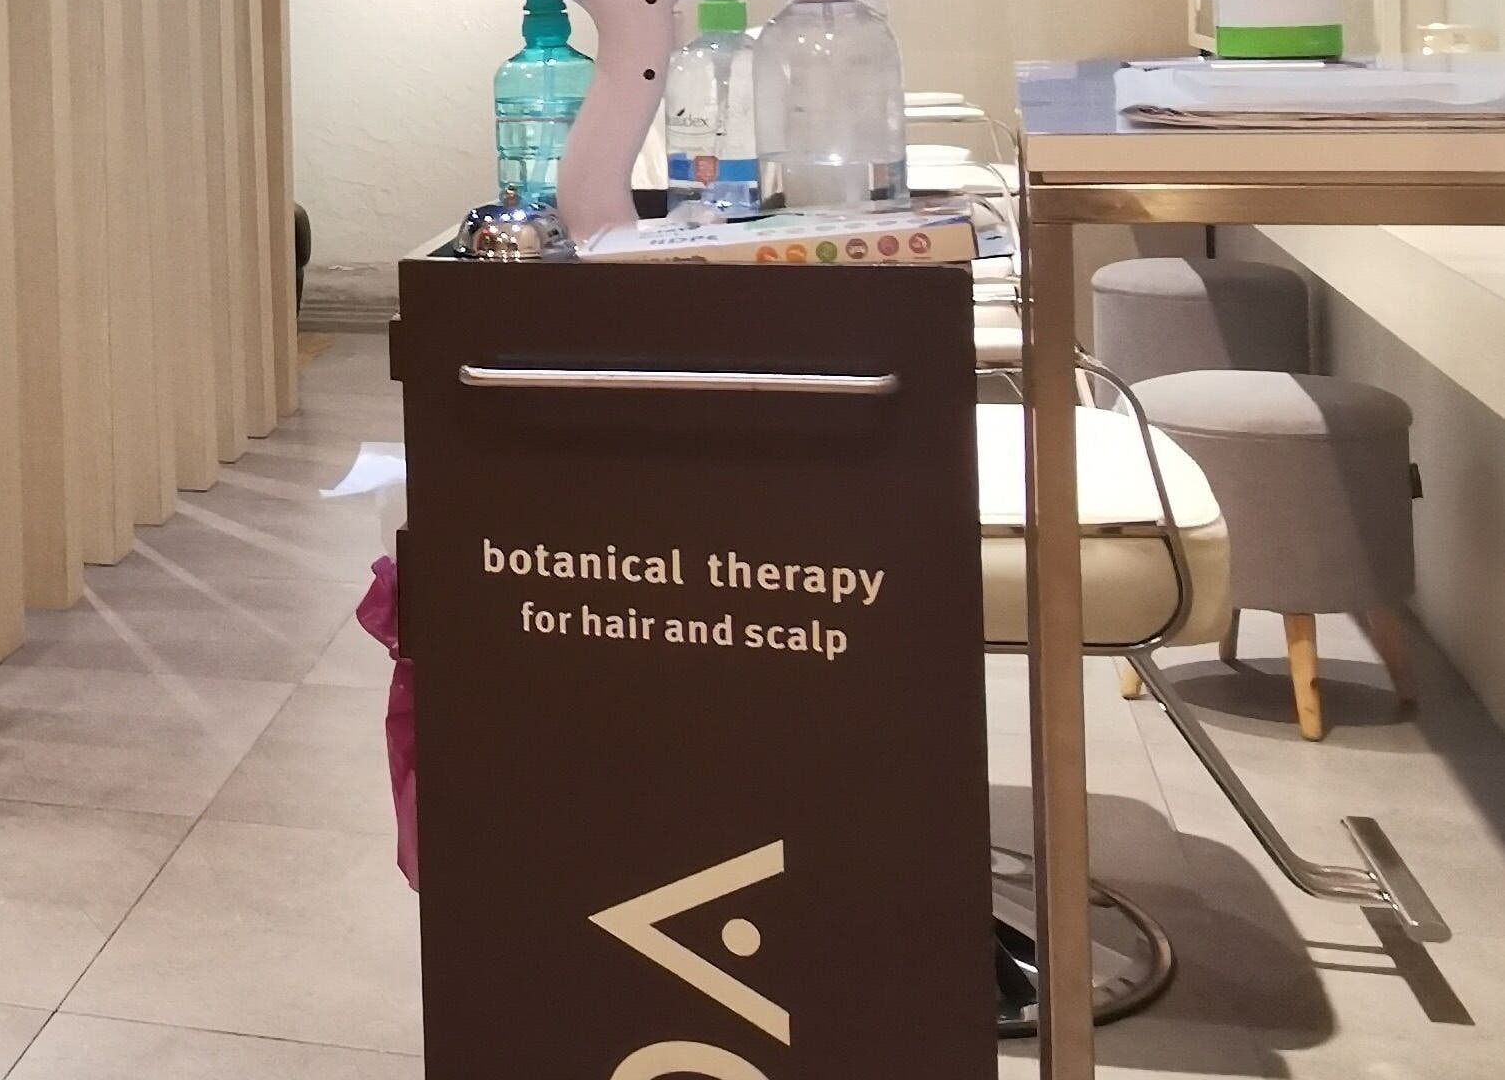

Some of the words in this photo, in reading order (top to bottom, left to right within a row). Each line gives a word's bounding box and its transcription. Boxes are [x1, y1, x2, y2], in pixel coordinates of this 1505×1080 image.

[483, 539, 685, 586] botanical
[707, 552, 885, 606] therapy
[521, 601, 572, 635] for
[582, 605, 656, 641] hair
[664, 615, 734, 647] and
[745, 620, 848, 661] scalp
